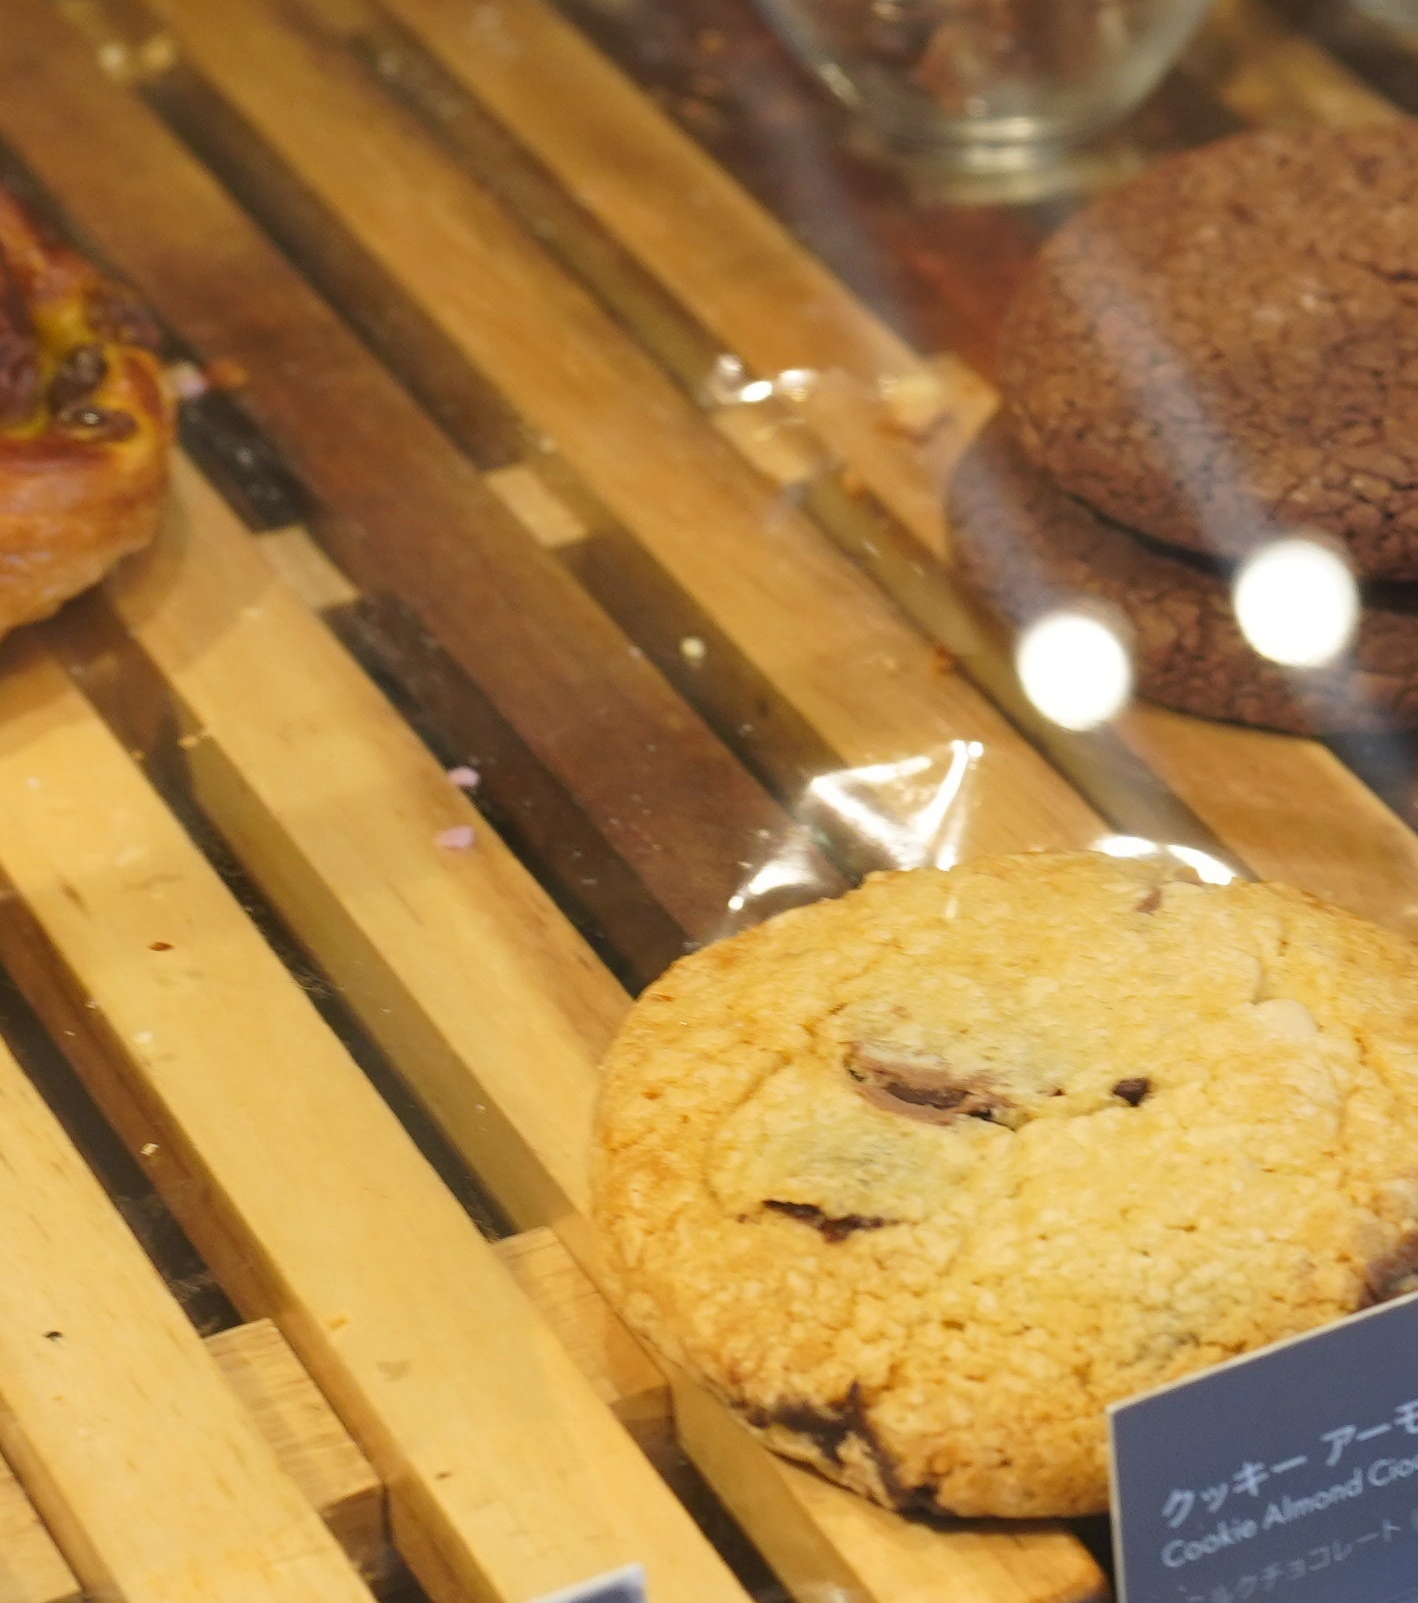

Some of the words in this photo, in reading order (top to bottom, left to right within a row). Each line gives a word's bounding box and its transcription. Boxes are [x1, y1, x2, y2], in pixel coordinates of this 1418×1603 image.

[1161, 1453, 1307, 1528] クッキー
[1161, 1512, 1258, 1568] Cookie
[1262, 1467, 1363, 1530] Almond
